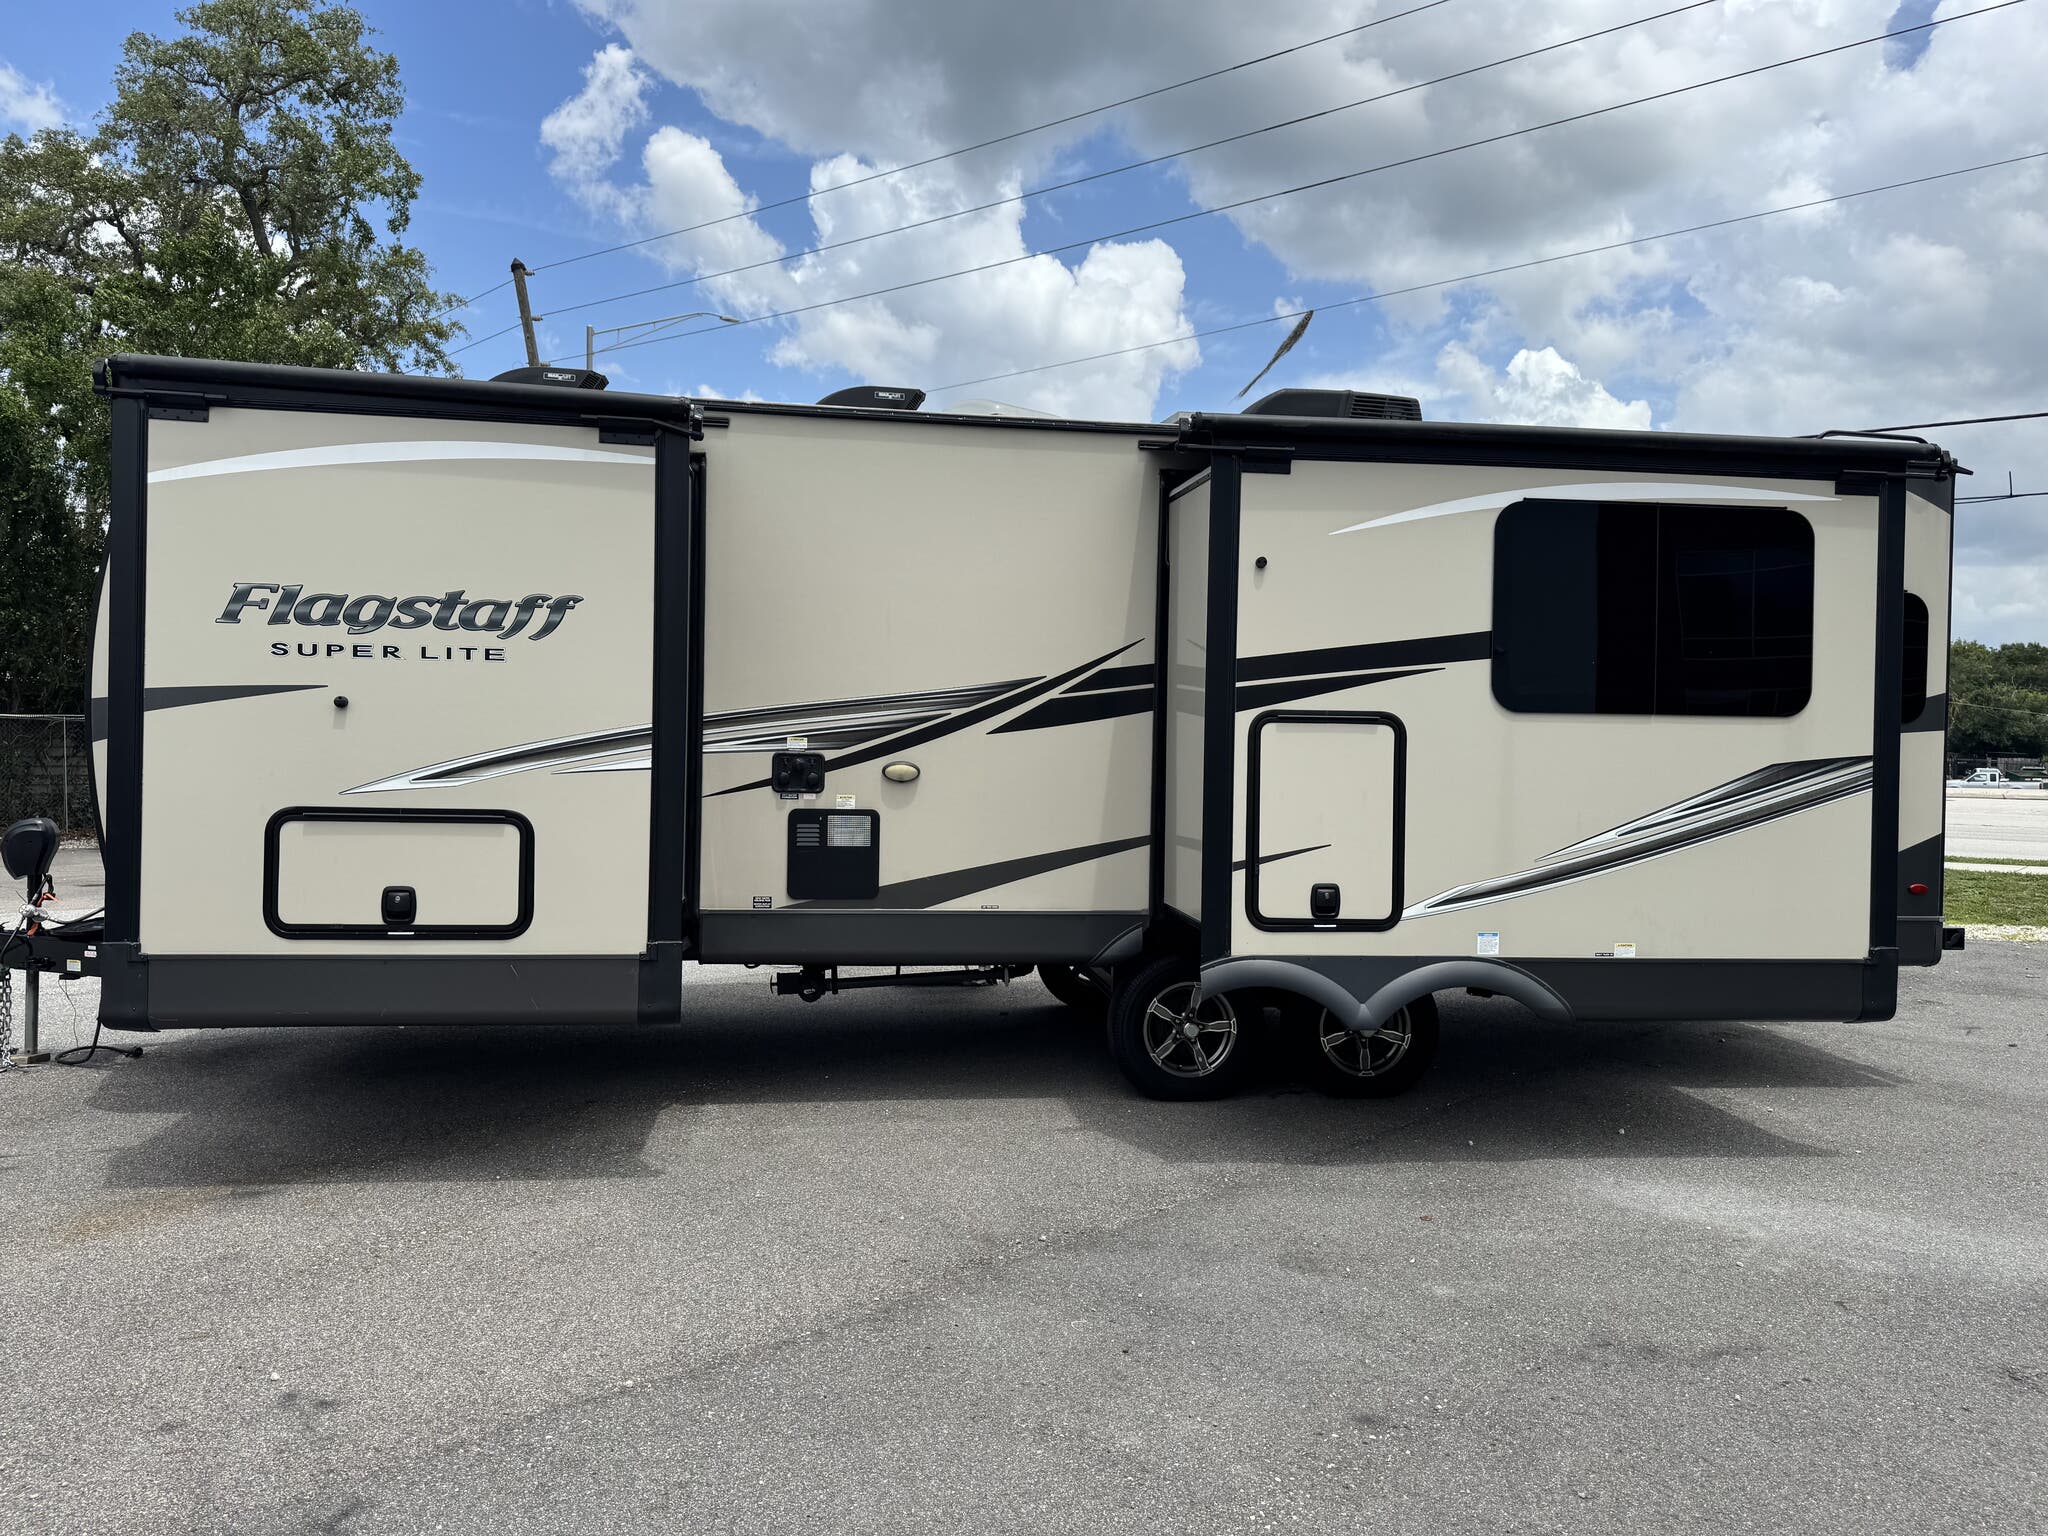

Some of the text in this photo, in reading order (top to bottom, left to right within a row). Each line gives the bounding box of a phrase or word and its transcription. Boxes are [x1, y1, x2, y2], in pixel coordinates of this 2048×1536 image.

[215, 582, 584, 641] Flagstaff
[270, 642, 506, 662] SUPER LITE
